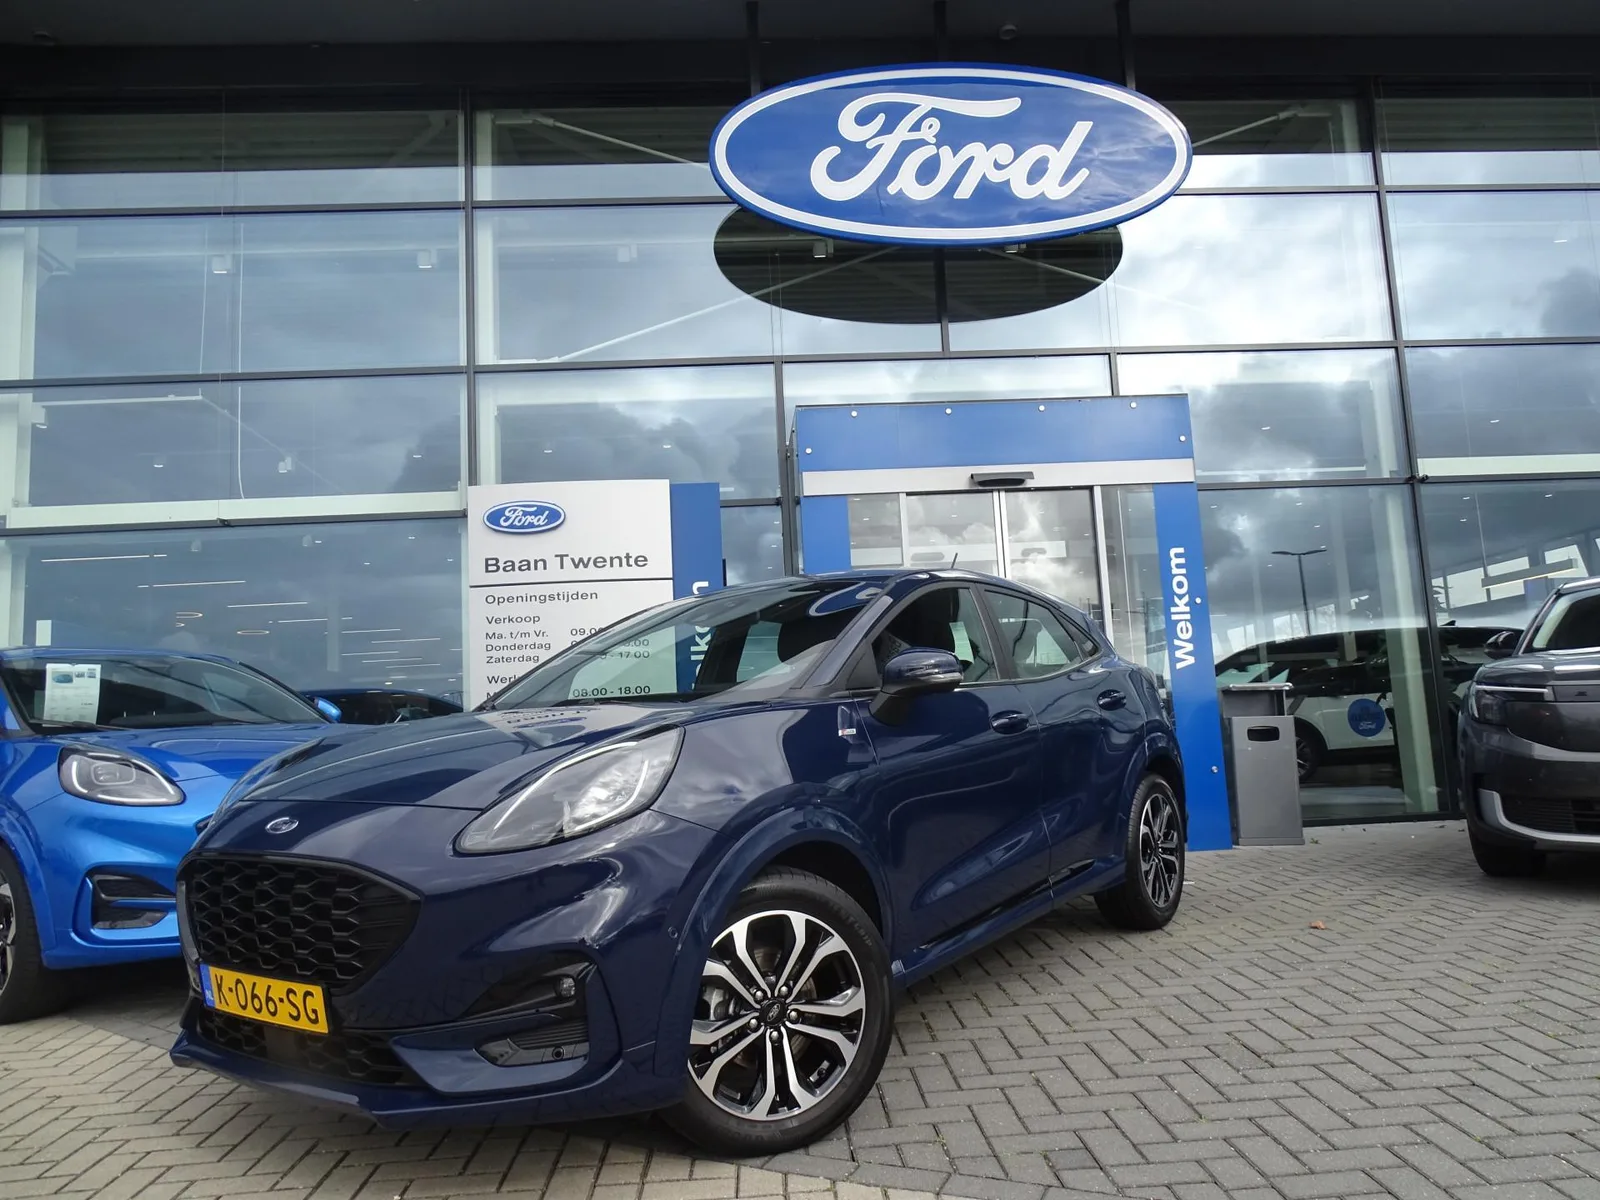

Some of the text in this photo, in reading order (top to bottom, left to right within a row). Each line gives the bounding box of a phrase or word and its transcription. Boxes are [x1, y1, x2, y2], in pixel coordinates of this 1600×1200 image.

[810, 92, 1094, 201] Ford
[500, 506, 549, 527] Ford
[484, 552, 649, 574] Baan Twente
[485, 591, 599, 606] Openingstijden
[1169, 547, 1196, 670] Welkom
[485, 615, 541, 625] Verkoop
[485, 632, 507, 641] Ma.
[510, 630, 531, 640] t/m
[534, 629, 549, 639] Vr.
[485, 642, 551, 652] Donderdag
[486, 655, 540, 664] Zaterdag
[573, 687, 608, 698] 08.00
[618, 685, 651, 696] 18.00
[214, 973, 321, 1026] K-066-SG
